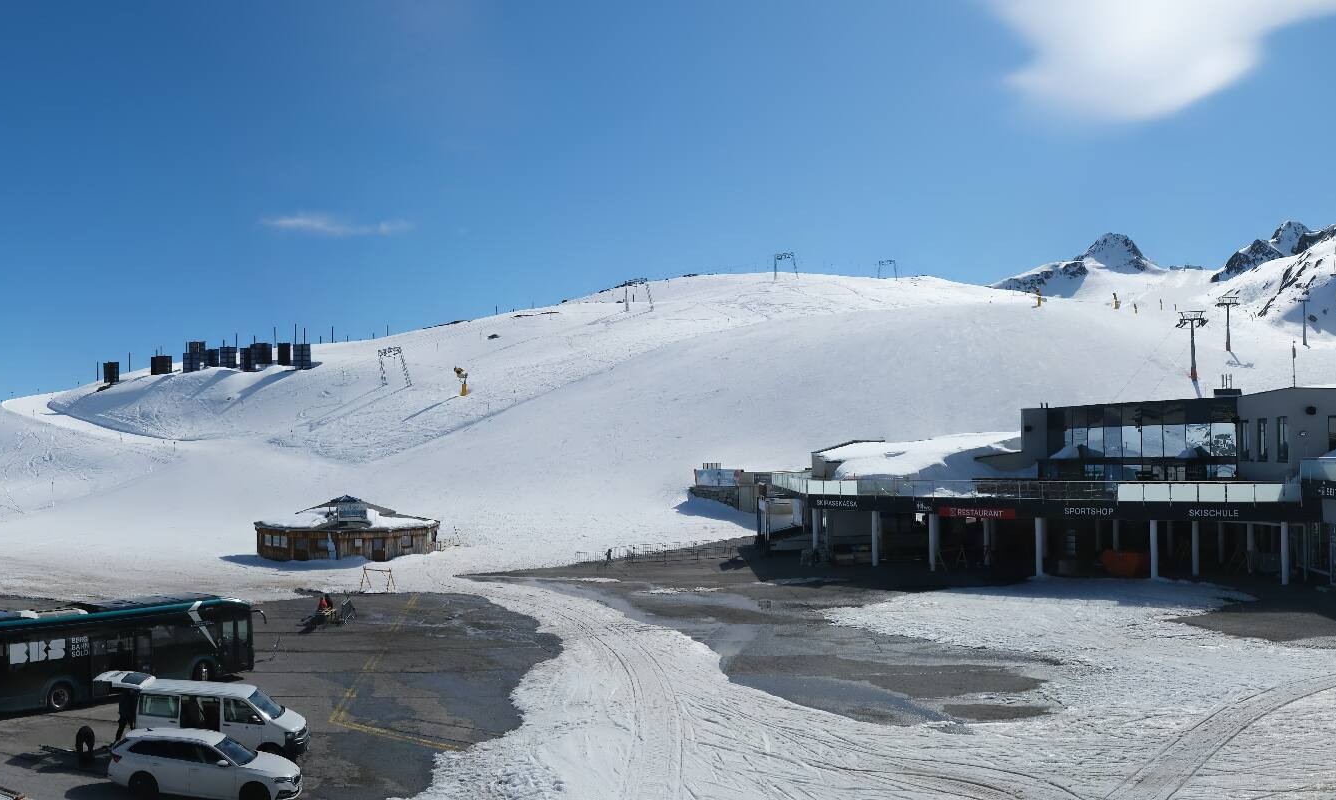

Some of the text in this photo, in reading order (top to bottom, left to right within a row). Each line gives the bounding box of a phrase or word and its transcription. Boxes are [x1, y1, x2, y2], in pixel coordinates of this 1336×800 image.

[957, 508, 1004, 517] RESTAURANT
[1064, 507, 1114, 515] SPORTSHOP
[1188, 509, 1239, 517] SKISCHULE
[71, 635, 89, 644] BERG
[71, 642, 90, 651] BAHN
